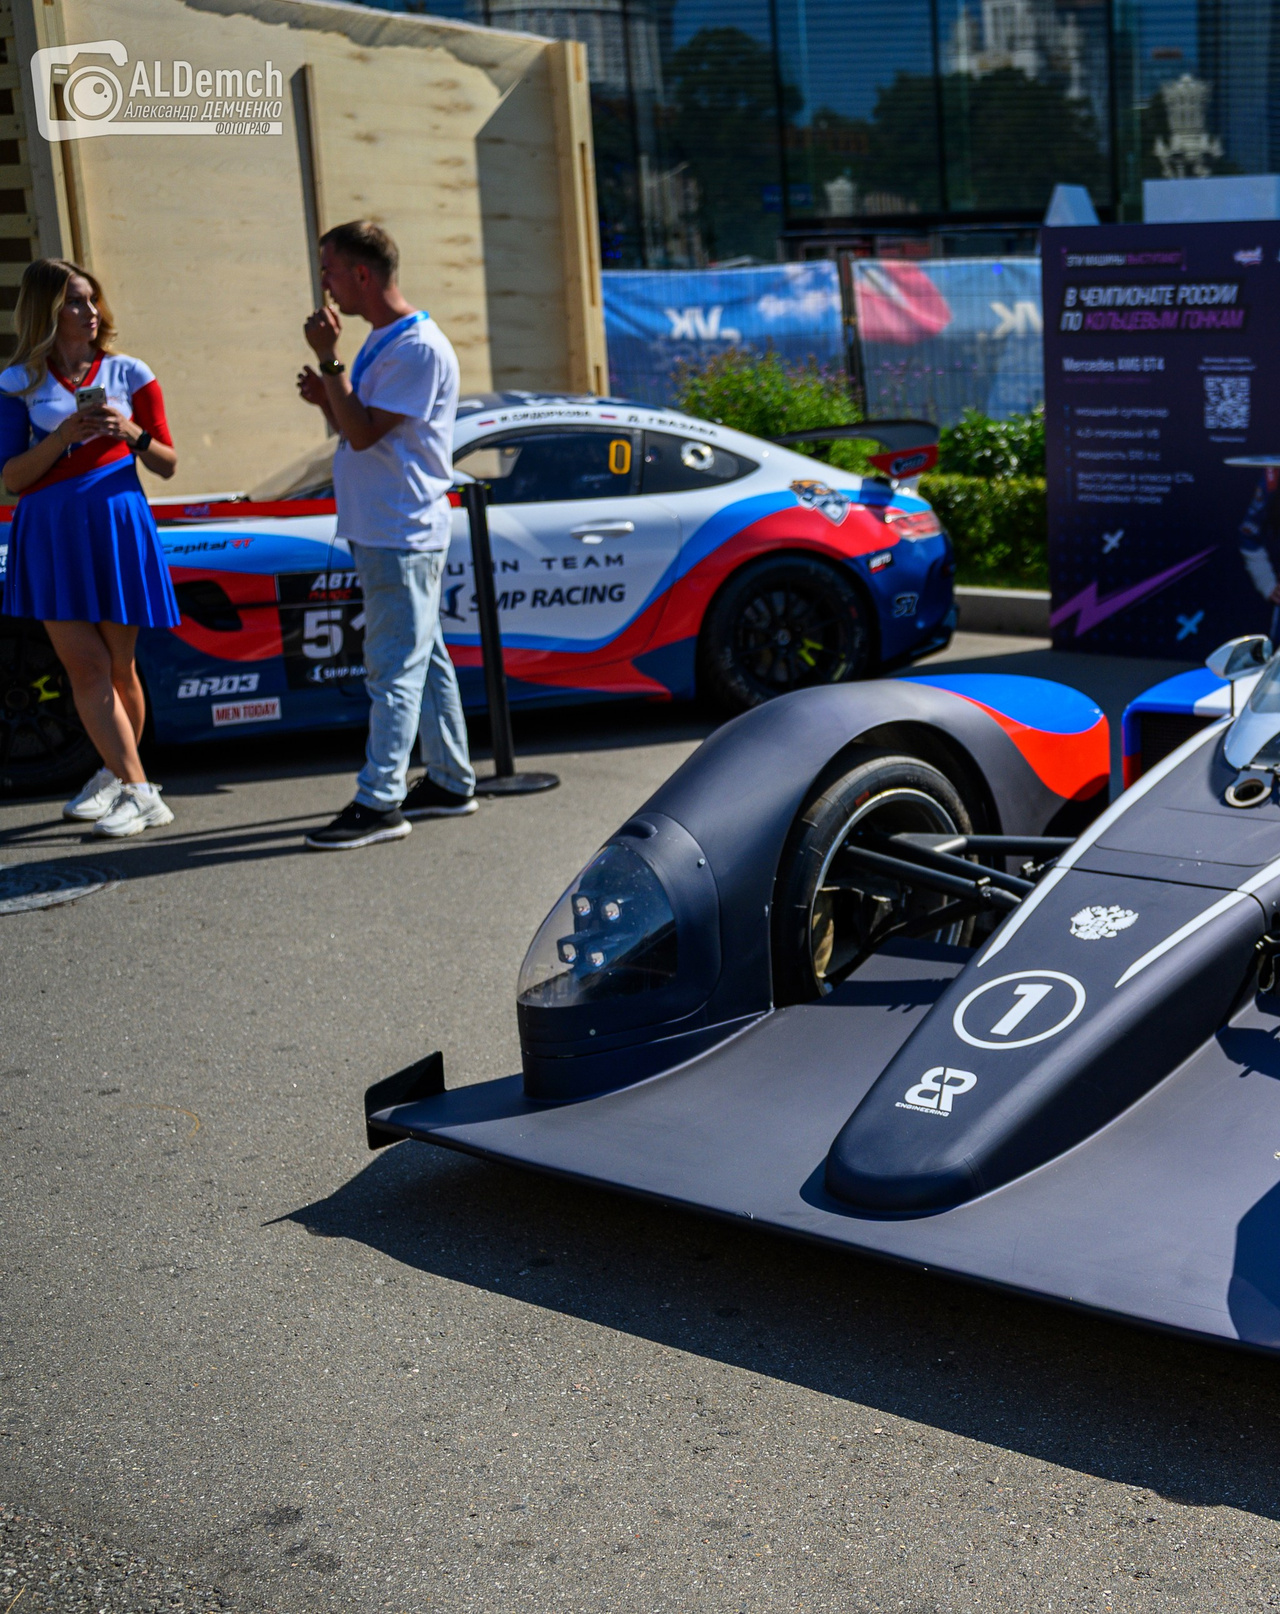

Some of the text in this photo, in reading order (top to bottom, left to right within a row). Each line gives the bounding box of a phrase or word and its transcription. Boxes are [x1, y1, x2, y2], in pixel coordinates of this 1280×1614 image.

[1064, 283, 1239, 308] В ЧЕМПИОНАТЕ РОССИИ
[1060, 310, 1083, 331] ПО
[541, 553, 625, 571] TEAM
[531, 584, 626, 608] RACING
[215, 702, 278, 722] MEN TODAY
[990, 983, 1054, 1036] 1
